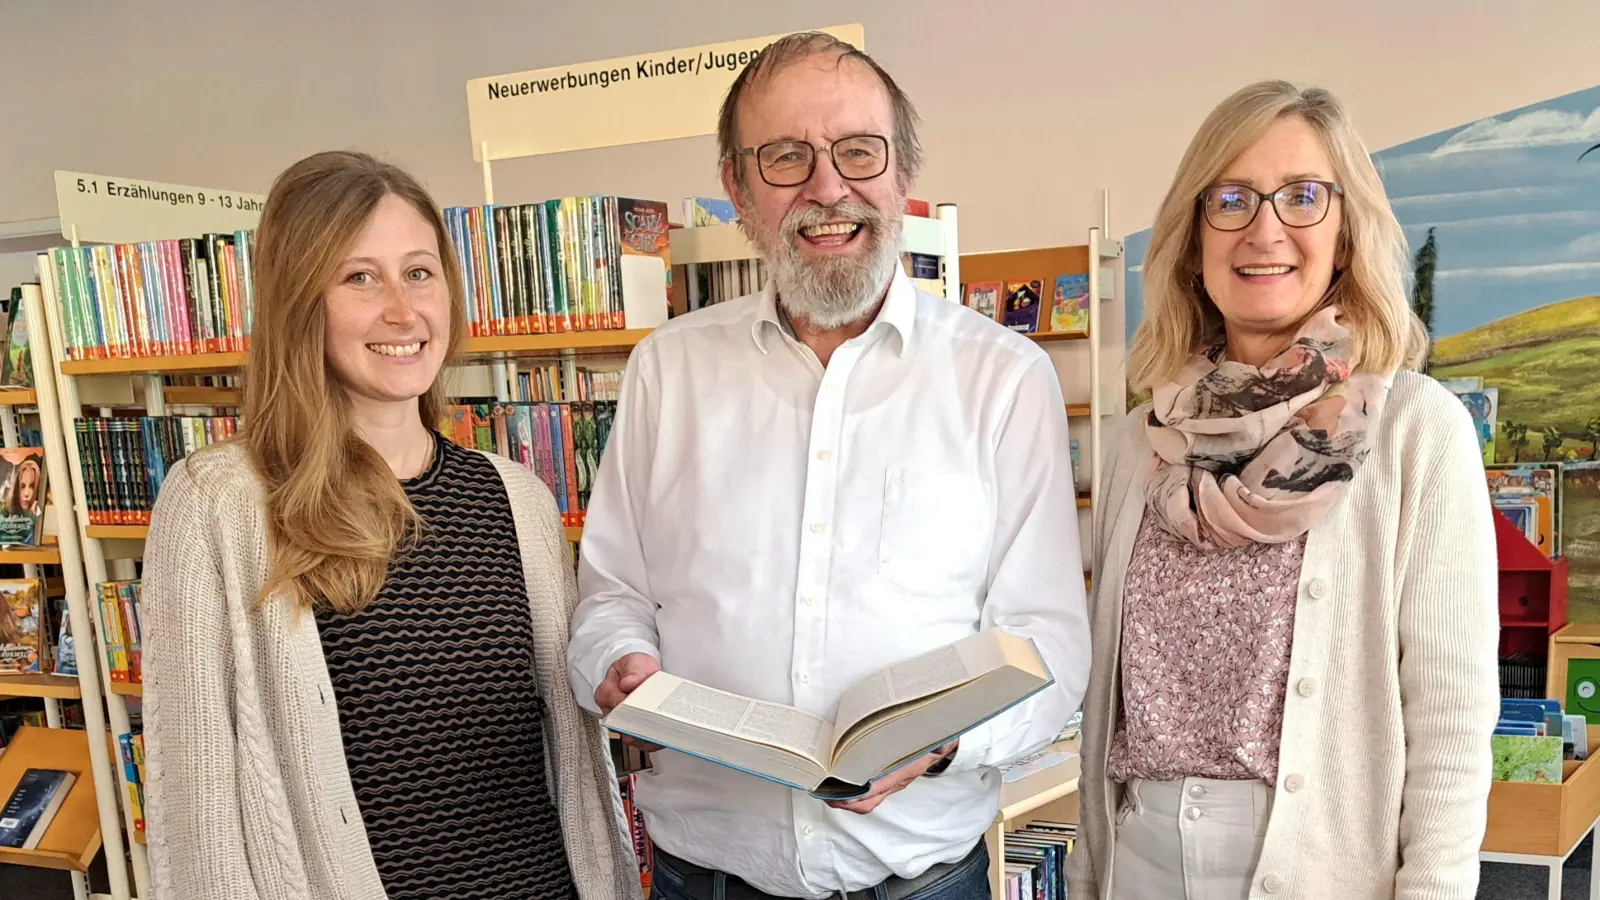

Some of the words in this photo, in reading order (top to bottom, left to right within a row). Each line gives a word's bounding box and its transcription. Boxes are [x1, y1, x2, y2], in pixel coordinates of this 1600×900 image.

[488, 67, 630, 100] Neuerwerbungen
[636, 49, 760, 79] Kinder/Jugen
[77, 178, 98, 194] 5.1
[107, 181, 194, 205] Erzählungen
[198, 192, 206, 205] 9
[218, 195, 233, 209] 13
[236, 196, 263, 212] Jahr
[624, 211, 662, 234] SCARY
